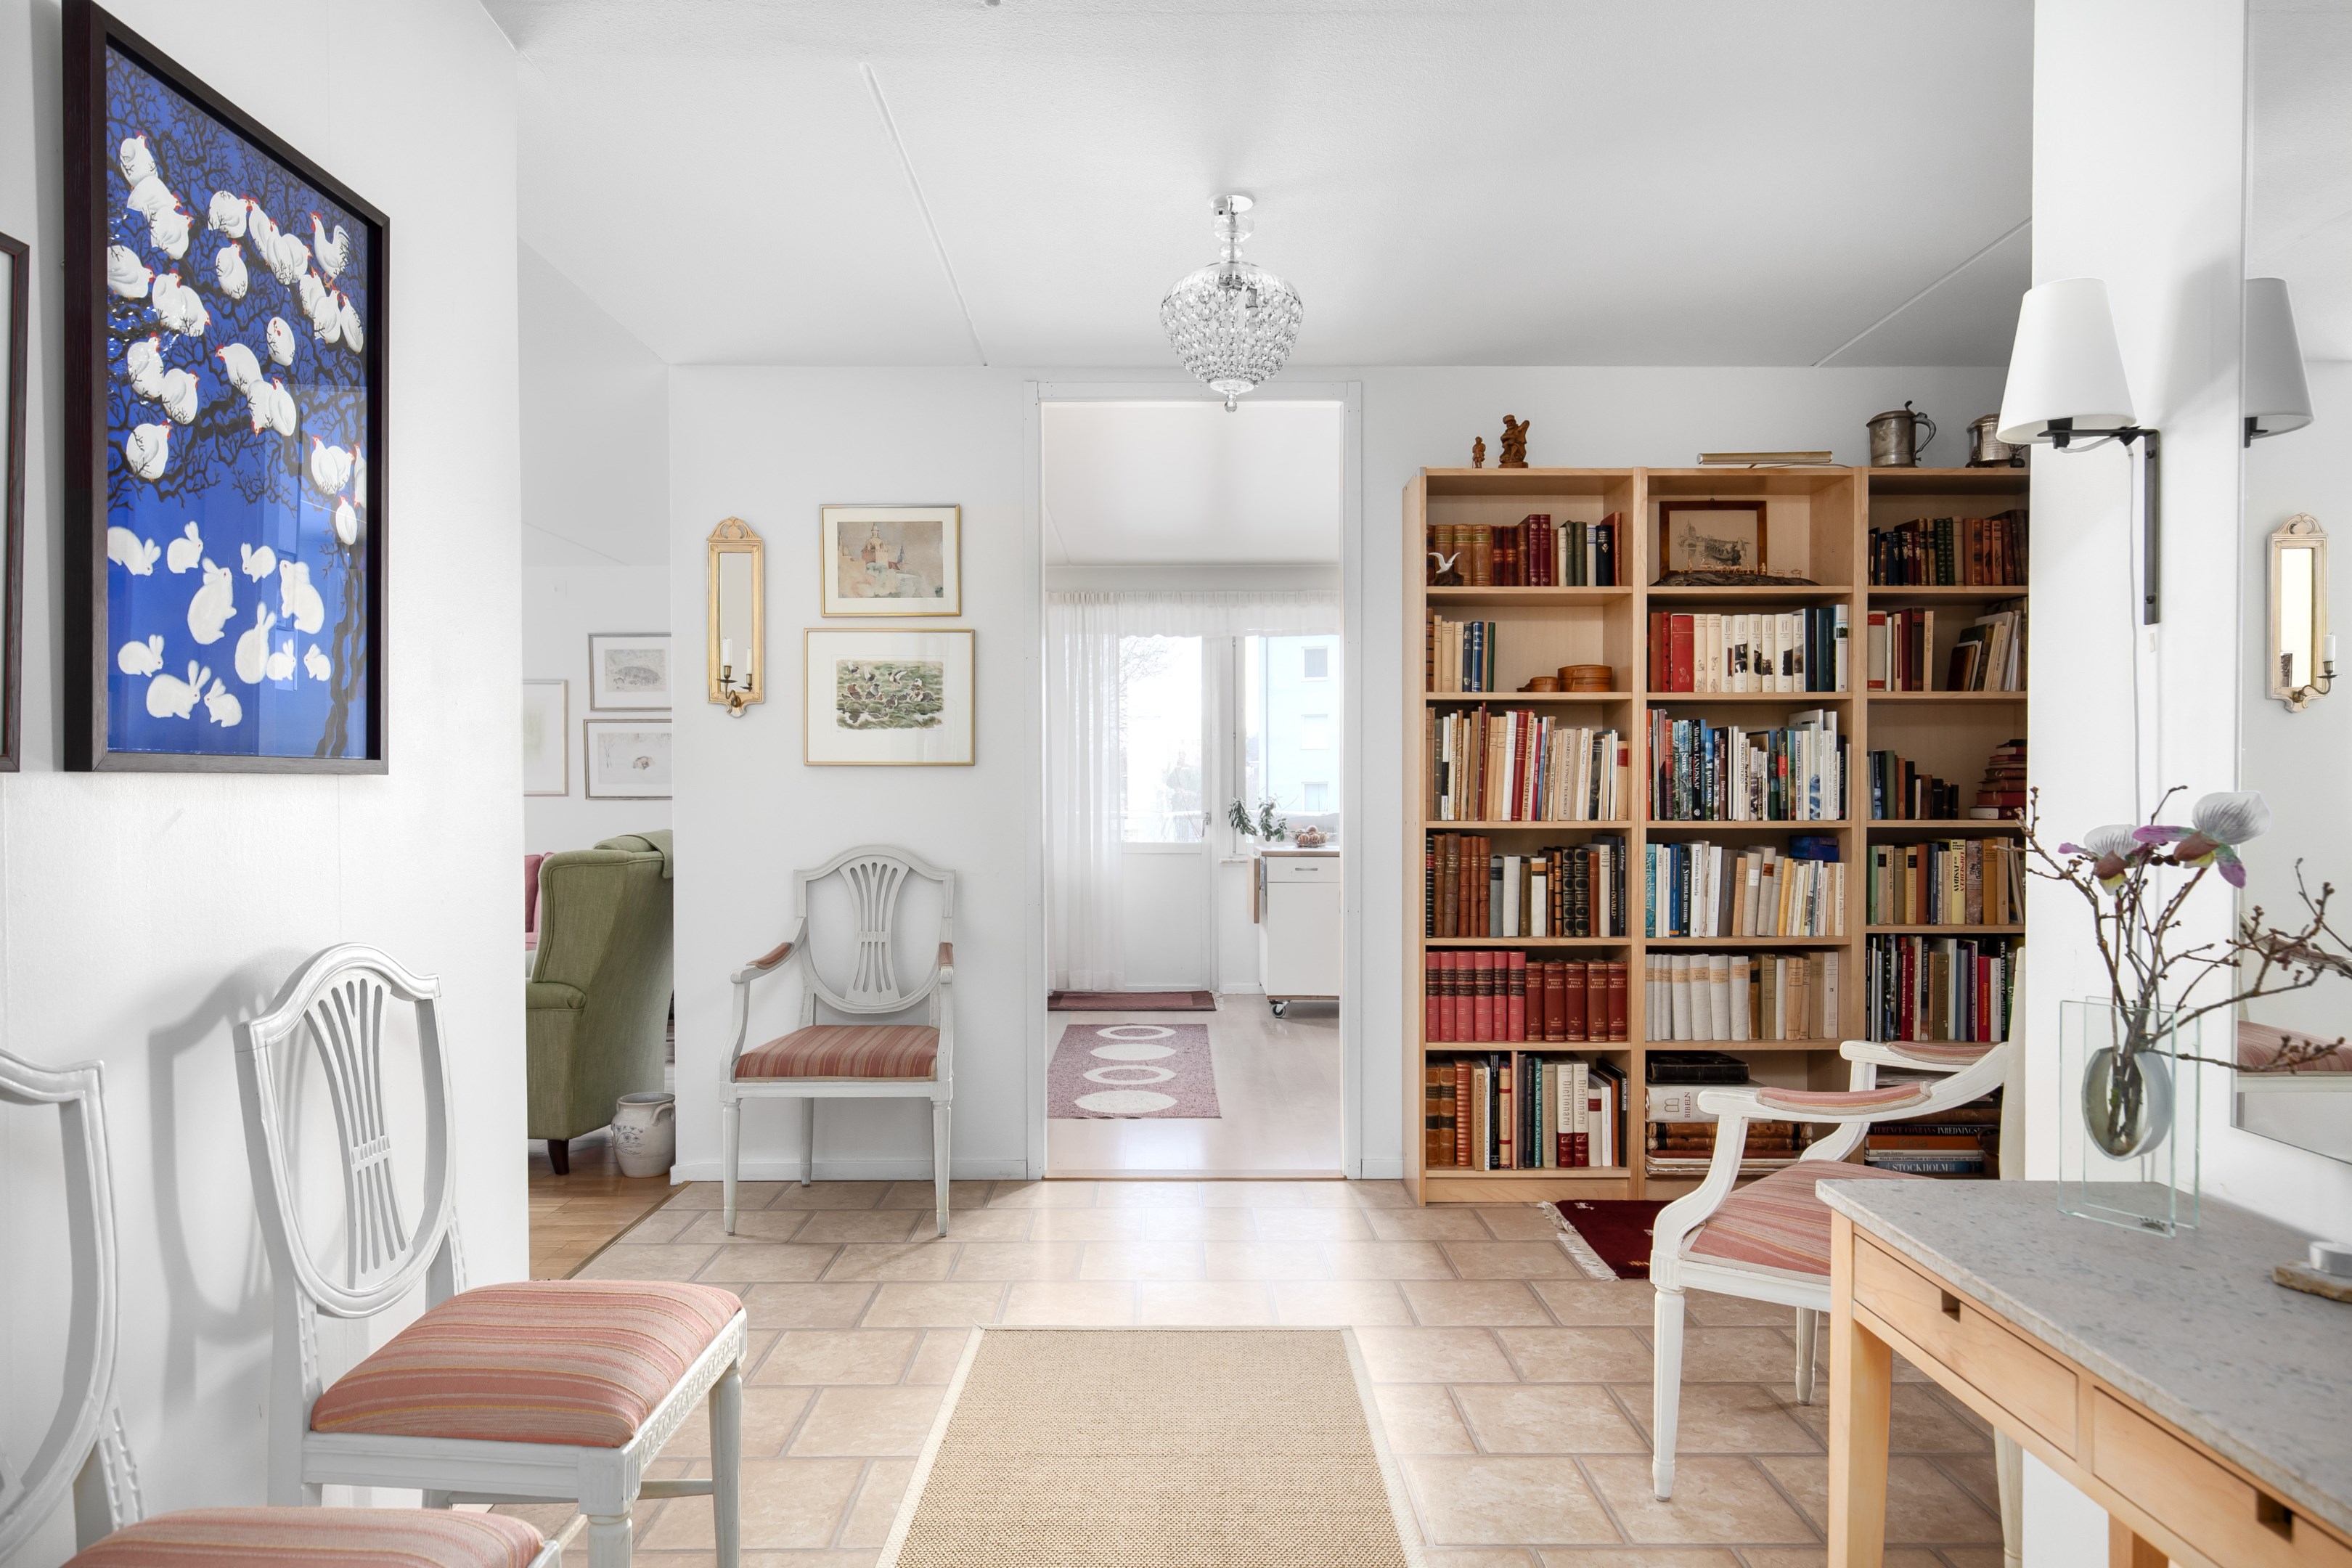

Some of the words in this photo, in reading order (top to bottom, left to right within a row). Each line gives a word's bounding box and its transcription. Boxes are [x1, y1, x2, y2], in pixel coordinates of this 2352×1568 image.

[1646, 854, 1654, 907] Sverigeboken
[1562, 1081, 1572, 1125] Dictionary
[1577, 1079, 1587, 1124] Dictionary
